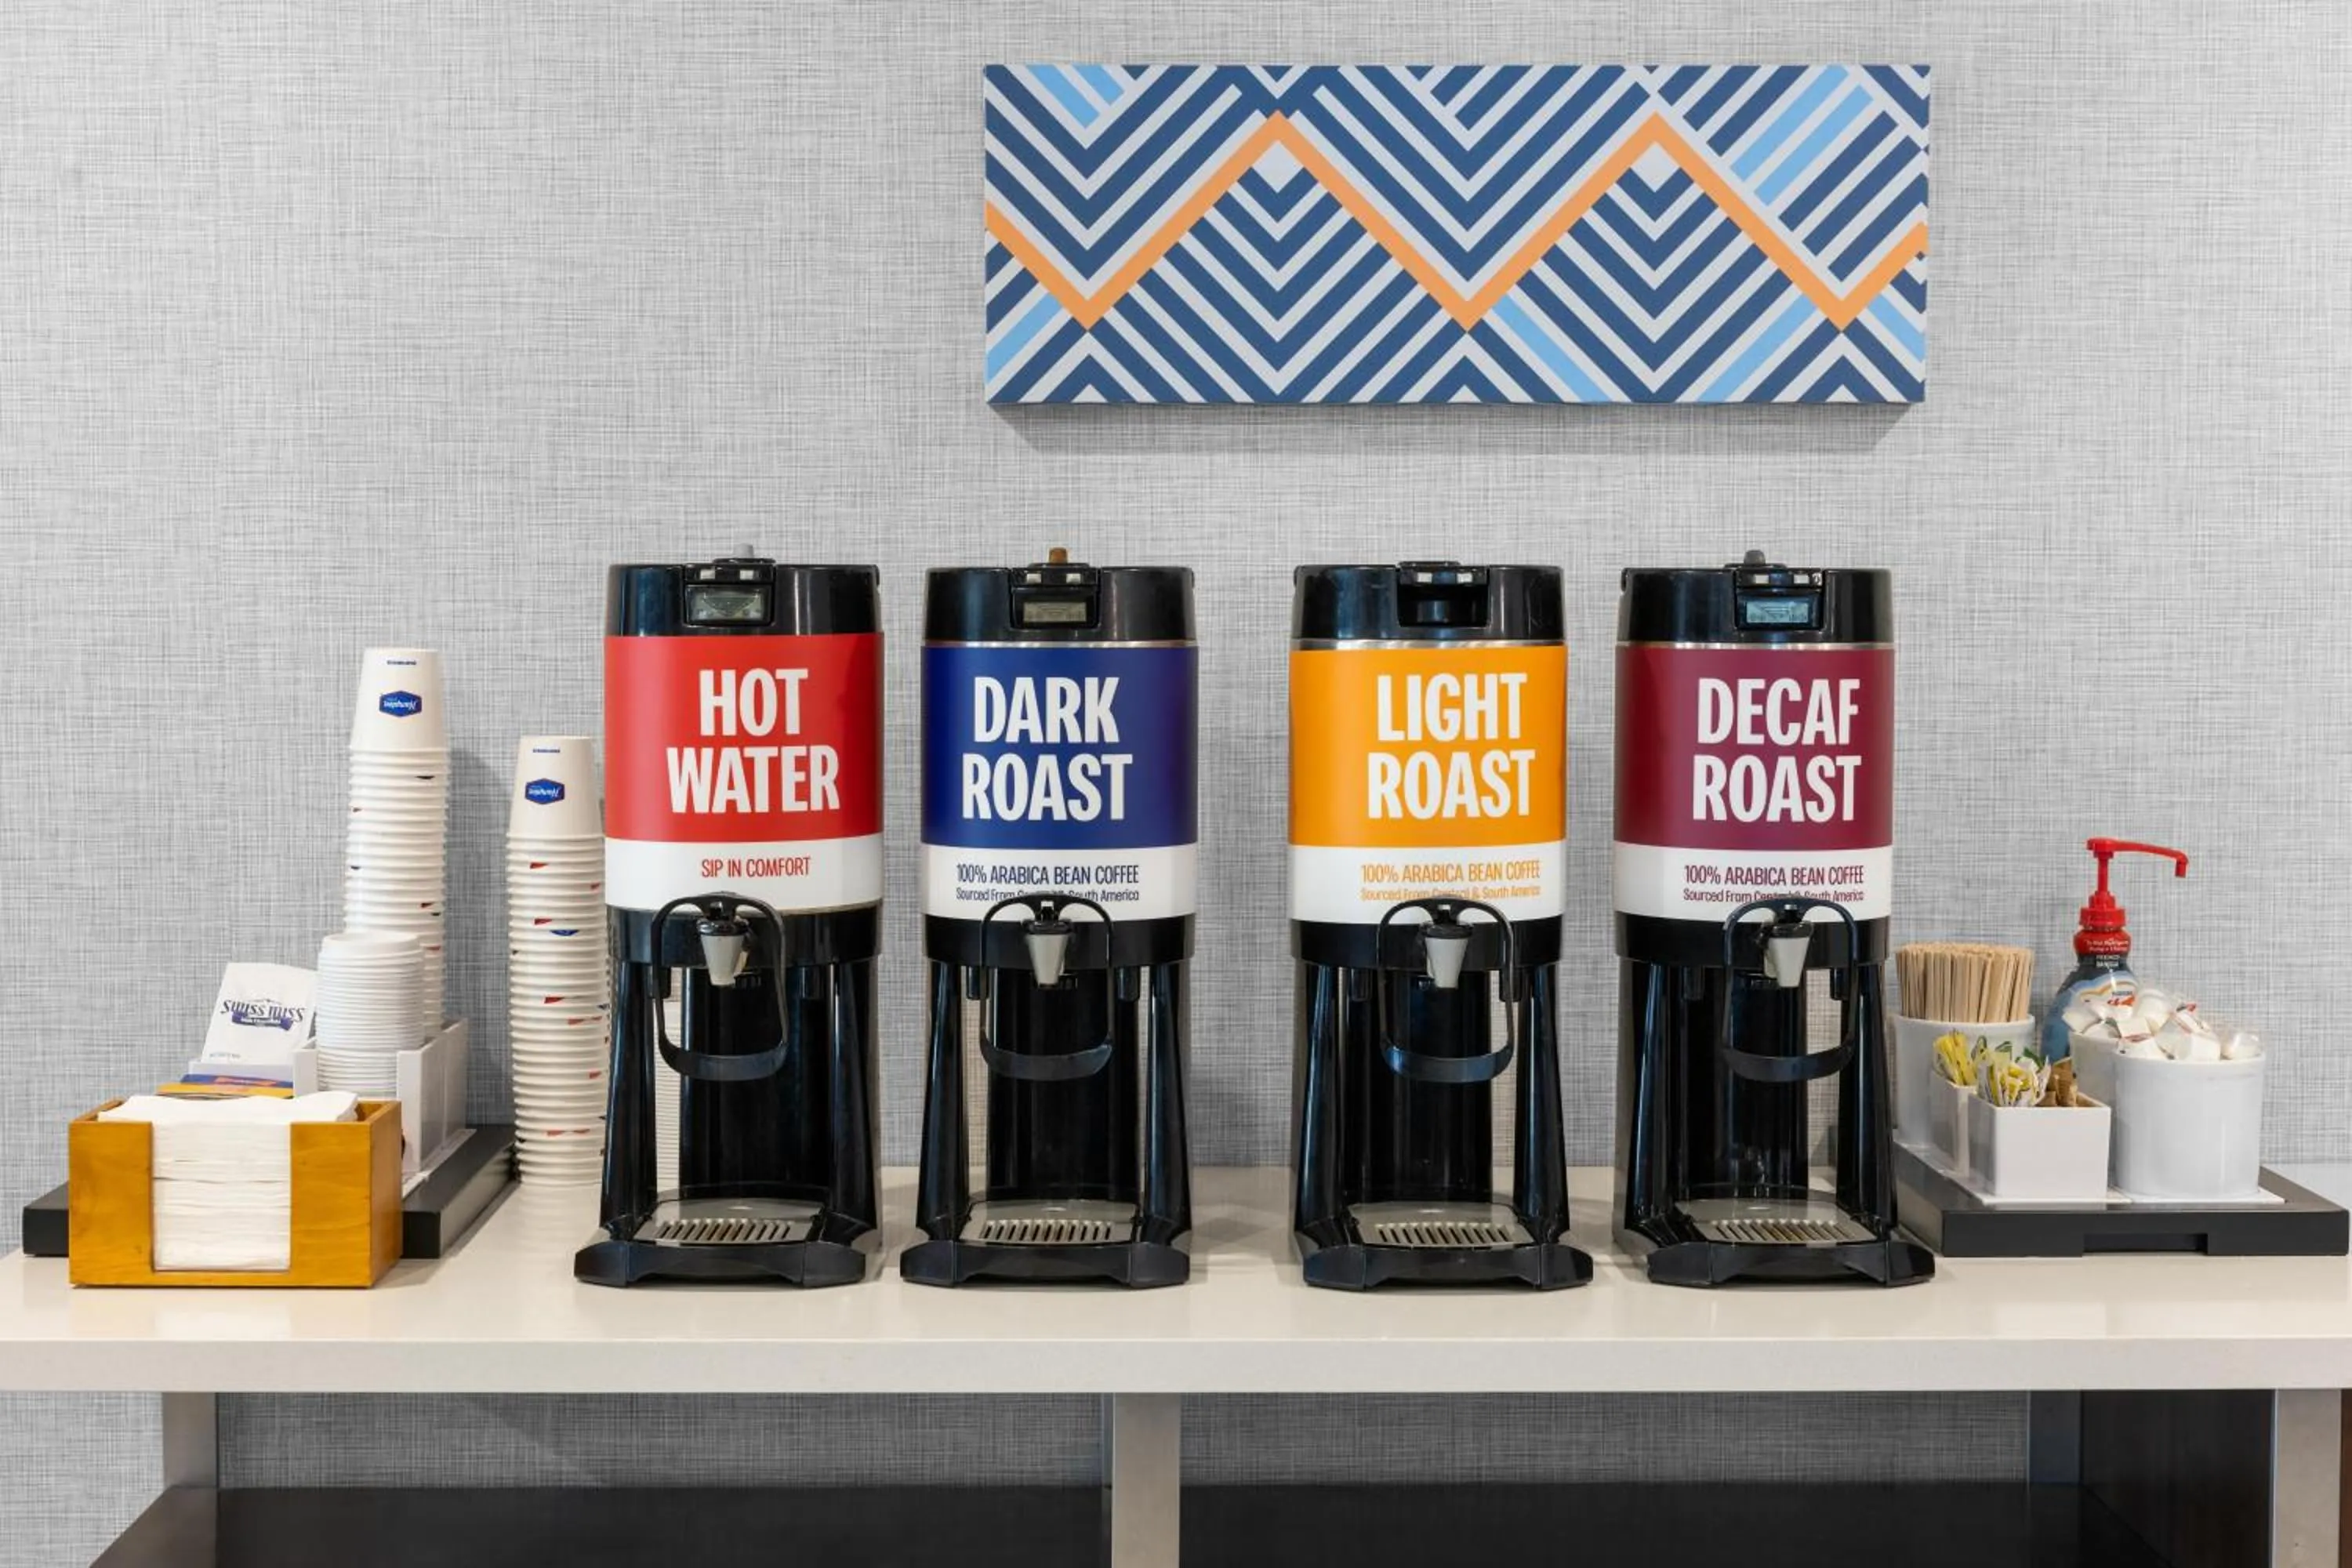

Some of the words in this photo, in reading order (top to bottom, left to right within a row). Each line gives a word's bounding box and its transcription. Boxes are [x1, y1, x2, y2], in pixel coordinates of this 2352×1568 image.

[700, 668, 808, 736] HOT
[975, 677, 1120, 743] DARK
[1377, 673, 1527, 742] LIGHT
[1697, 677, 1860, 746] DECAF
[666, 746, 840, 813] WATER
[963, 753, 1133, 821] ROAST
[1367, 750, 1535, 819] ROAST
[1693, 754, 1861, 822] ROAST
[702, 858, 724, 878] SIP
[728, 858, 742, 878] IN
[746, 857, 811, 877] COMFORT
[956, 864, 987, 884] 100%
[990, 866, 1050, 885] ARABICA
[1054, 866, 1091, 885] BEAN
[1095, 865, 1139, 884] COFFEE
[956, 887, 989, 901] Sourced
[991, 889, 1014, 902] From
[1101, 890, 1139, 902] America
[1361, 864, 1399, 883] 100%
[1402, 864, 1464, 883] ARABICA
[1468, 862, 1504, 882] BEAN
[1506, 861, 1541, 880] COFFEE
[1361, 887, 1401, 900] Sourced
[1483, 887, 1509, 898] South
[1683, 888, 1724, 902] Sourced
[1726, 890, 1752, 902] From
[1832, 890, 1864, 902] America
[1685, 865, 1721, 884] 100%
[1725, 866, 1787, 886] ARABICA
[1791, 867, 1825, 885] BEAN
[1828, 866, 1864, 884] COFFEE
